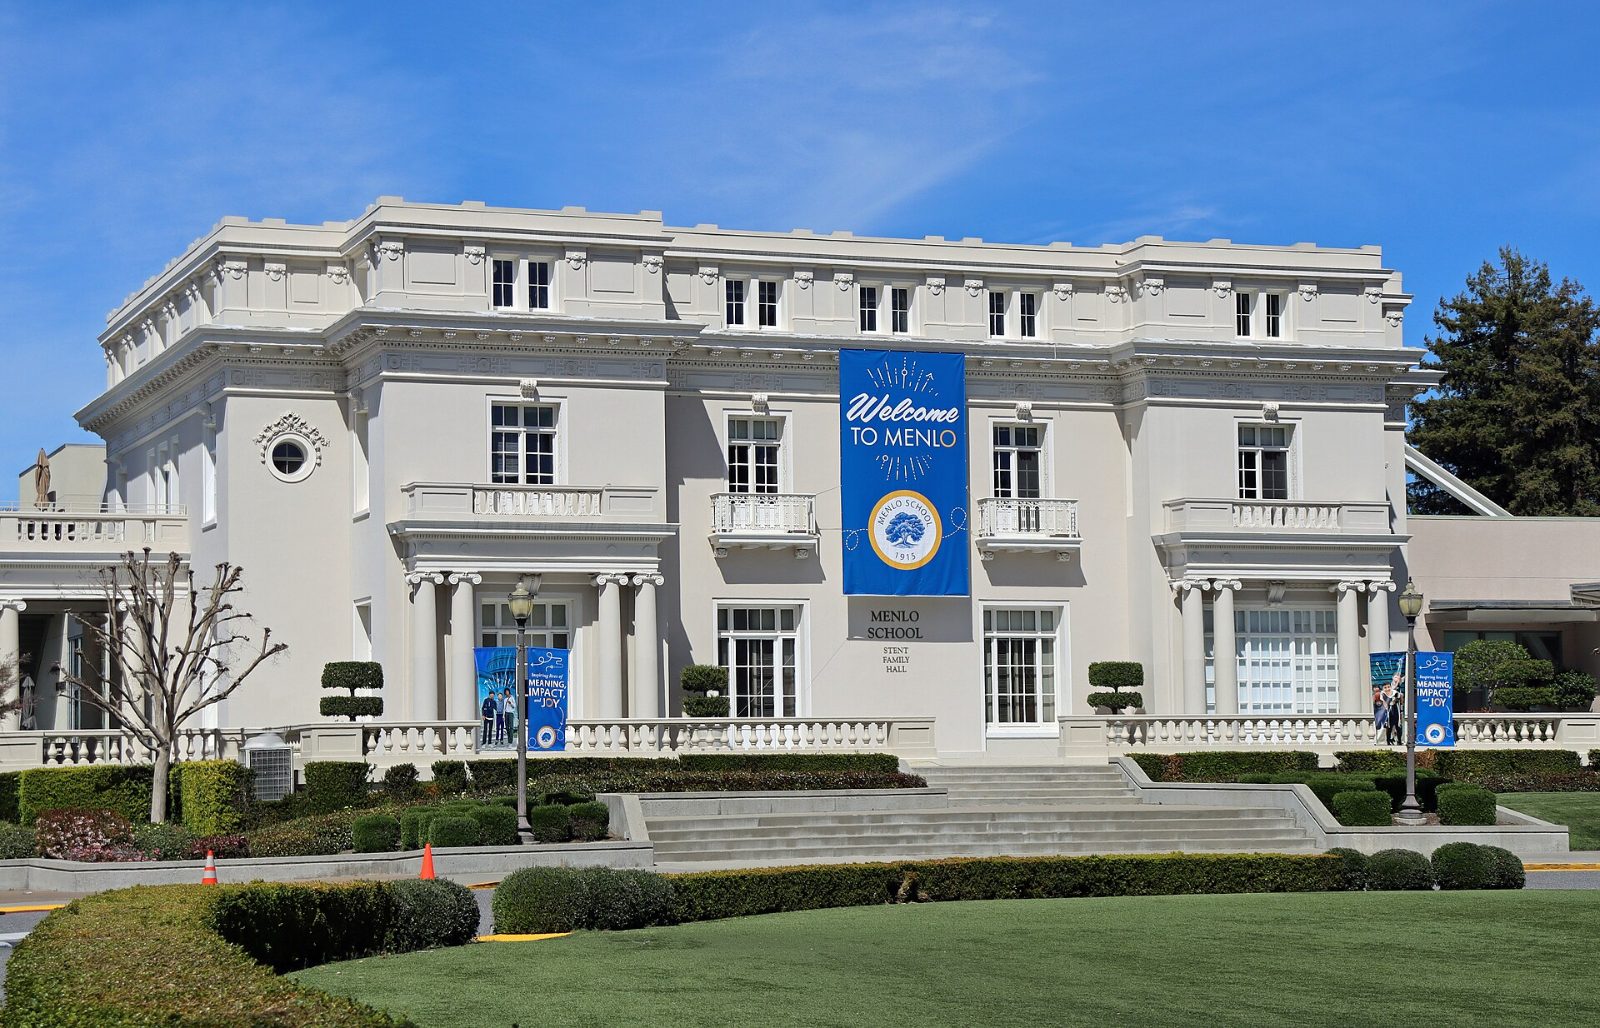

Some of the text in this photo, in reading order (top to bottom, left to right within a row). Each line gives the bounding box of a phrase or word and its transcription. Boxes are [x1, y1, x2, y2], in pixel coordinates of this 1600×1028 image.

[846, 393, 960, 423] Welcome
[850, 427, 957, 448] TO MENLO
[878, 499, 933, 528] MENLO SCHOOL
[895, 552, 916, 561] 1915
[871, 610, 920, 622] MENLO
[867, 627, 924, 639] SCHOOL
[883, 646, 909, 654] STENT
[882, 656, 910, 664] FAMILY
[886, 665, 907, 673] HALL
[528, 679, 567, 690] MEANING,
[1416, 680, 1451, 690] MEANING,
[528, 687, 566, 699] IMPACT,
[541, 697, 560, 708] JOY
[1429, 697, 1447, 707] JOY
